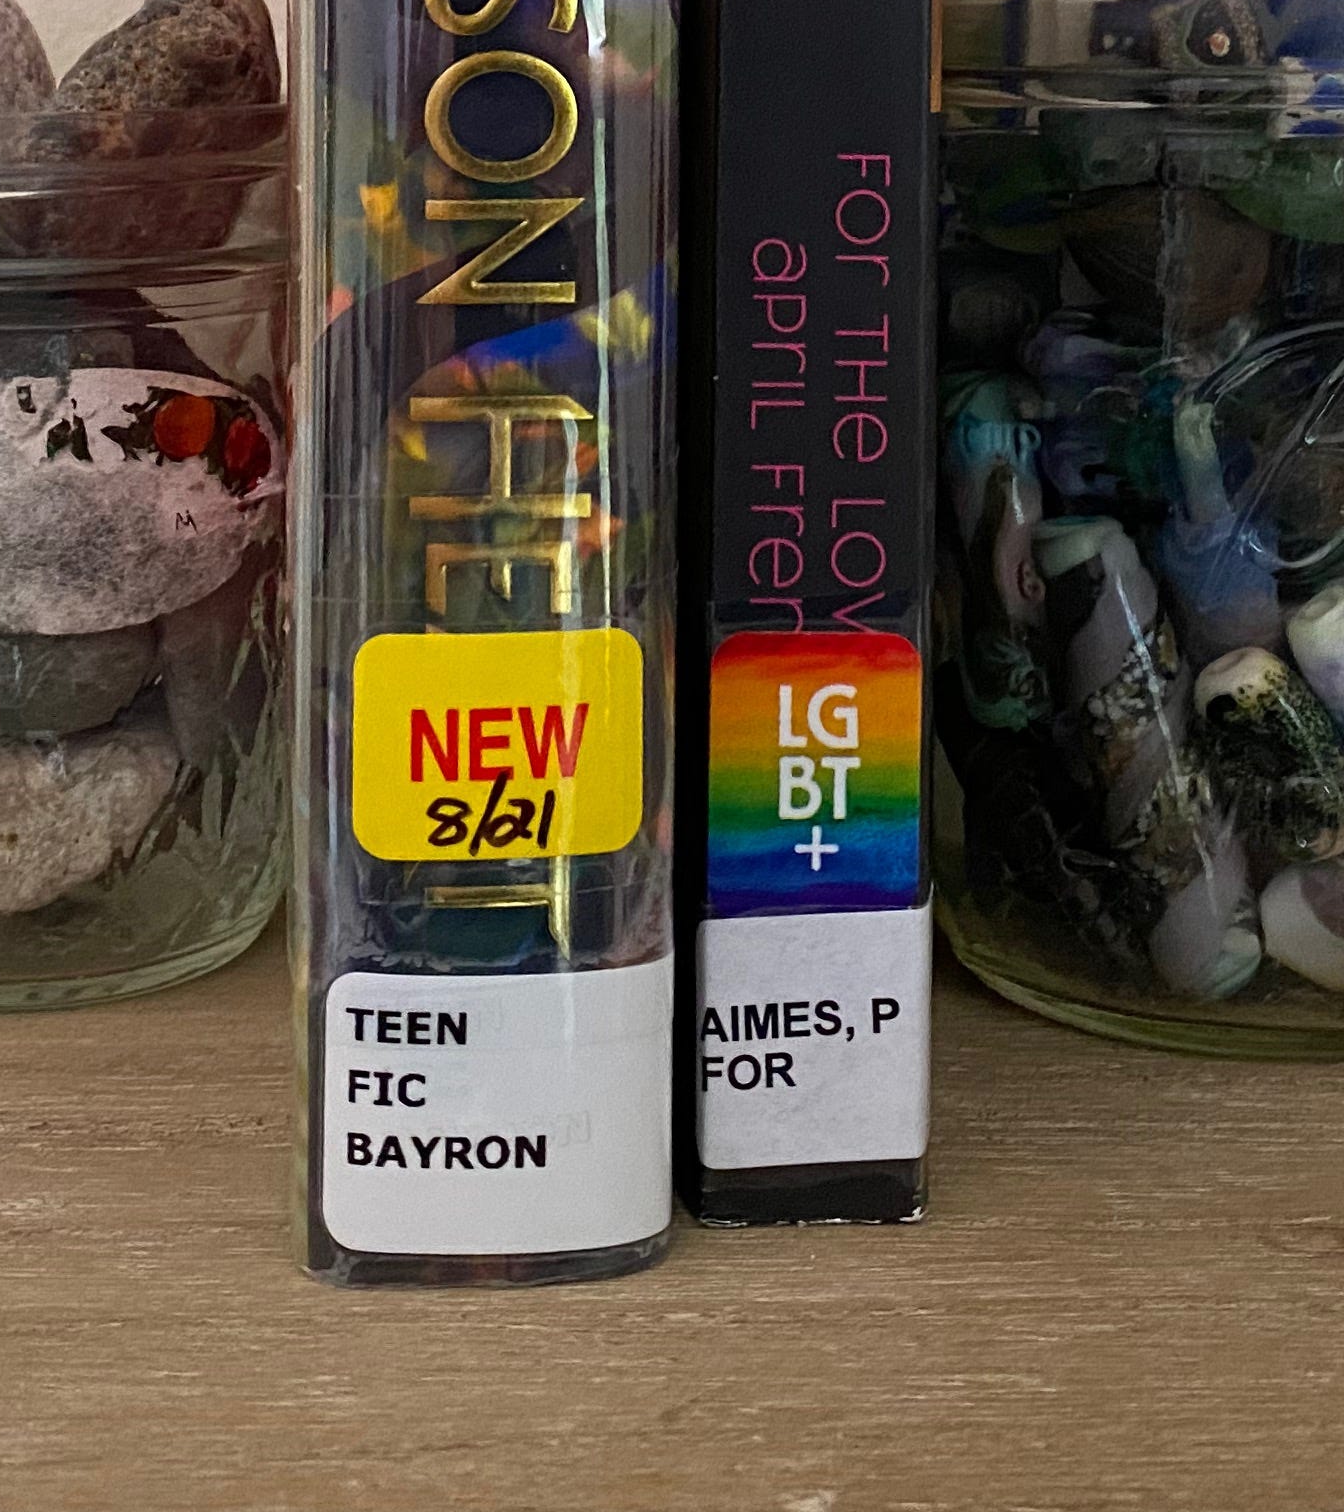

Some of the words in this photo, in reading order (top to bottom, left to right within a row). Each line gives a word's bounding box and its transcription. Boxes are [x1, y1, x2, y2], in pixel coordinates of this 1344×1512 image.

[777, 683, 859, 750] LG
[410, 703, 590, 782] NEW
[777, 755, 862, 822] BT
[425, 770, 557, 857] 8/21
[345, 1006, 469, 1046] TEEN
[699, 997, 857, 1044] AIMES,
[870, 996, 901, 1035] P
[347, 1068, 428, 1108] FIC
[699, 1050, 797, 1093] FOR
[346, 1131, 548, 1170] BAYRON
